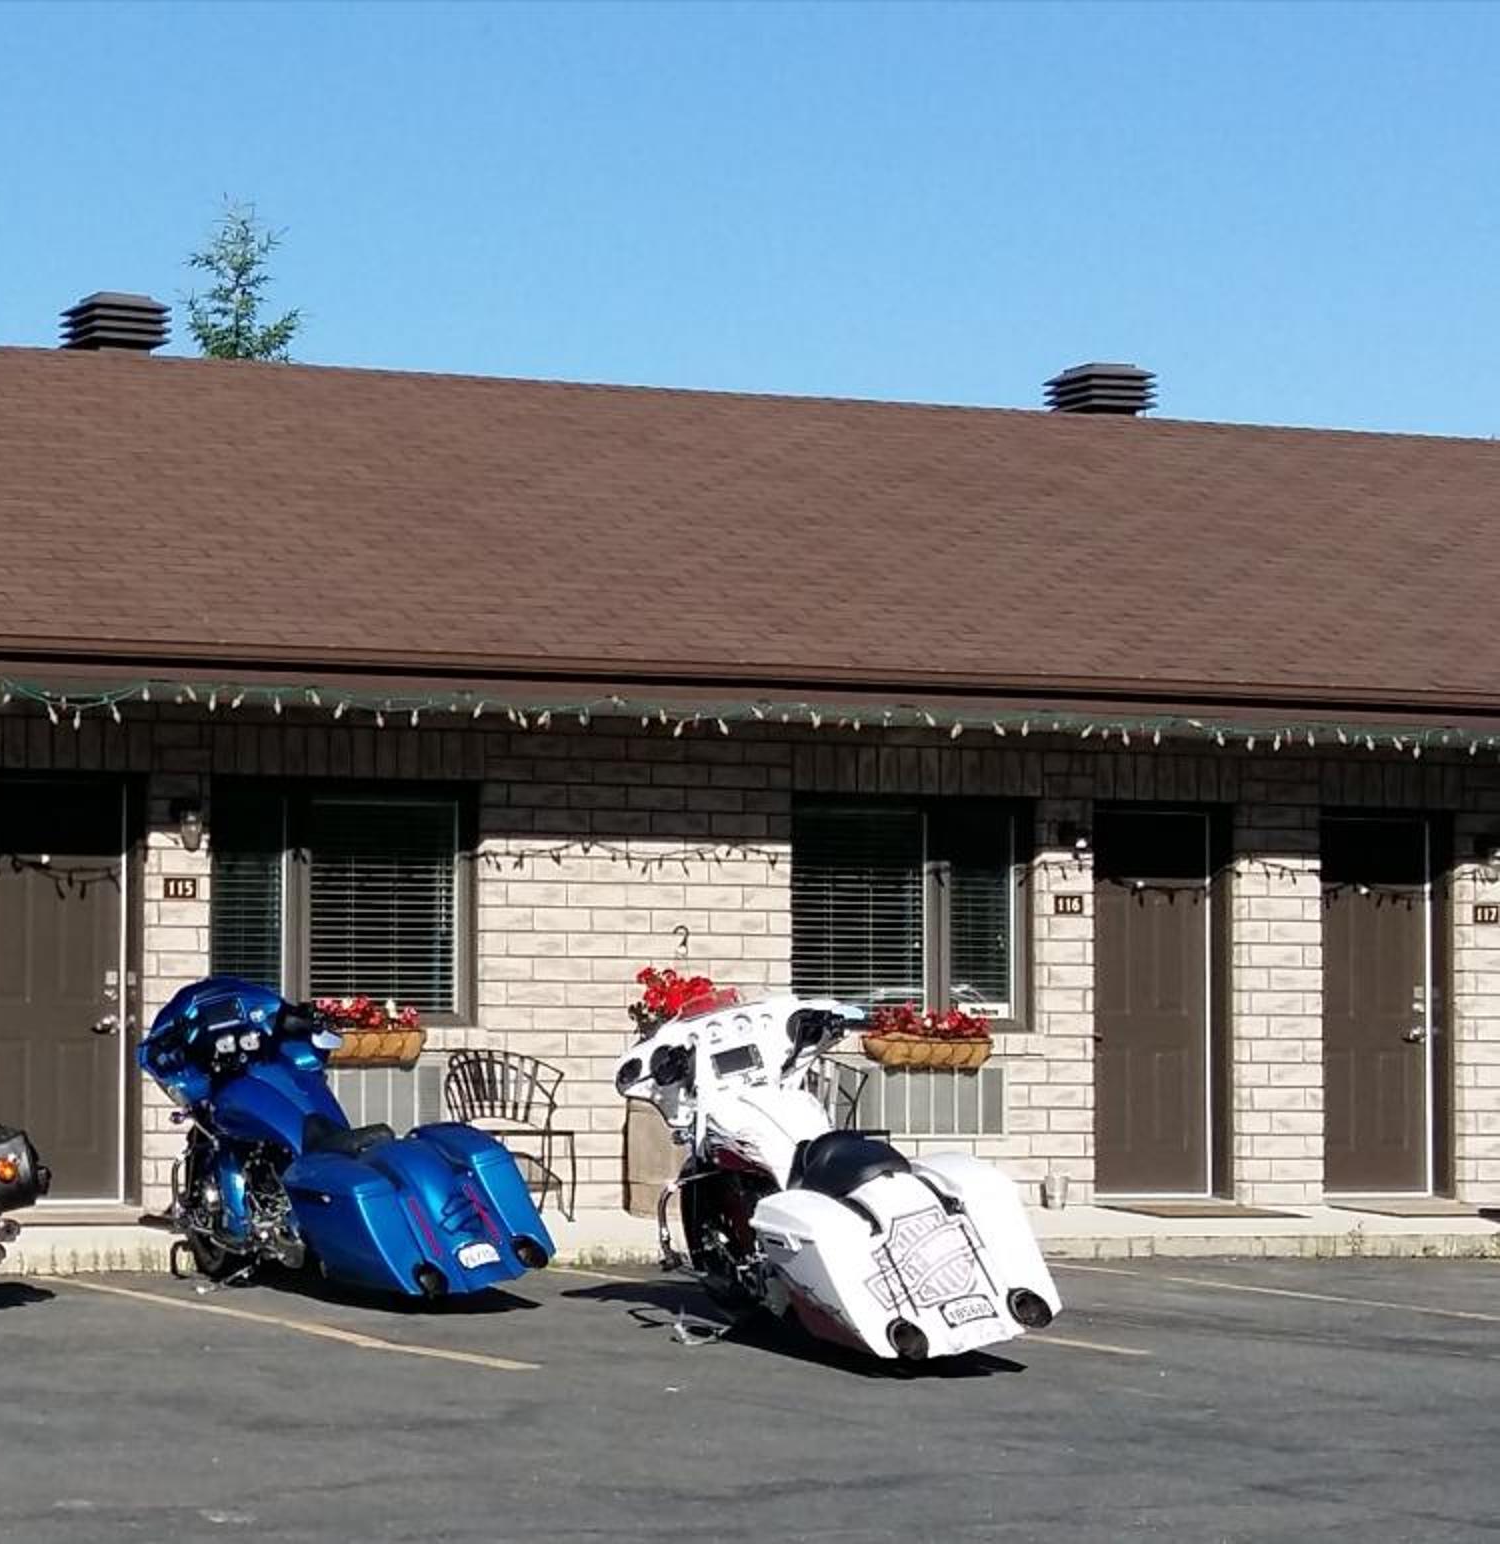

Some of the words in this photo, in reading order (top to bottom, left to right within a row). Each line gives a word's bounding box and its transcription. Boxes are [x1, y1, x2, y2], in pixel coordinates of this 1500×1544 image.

[168, 880, 194, 896] 115
[1058, 897, 1081, 912] 116
[1477, 907, 1497, 921] 117
